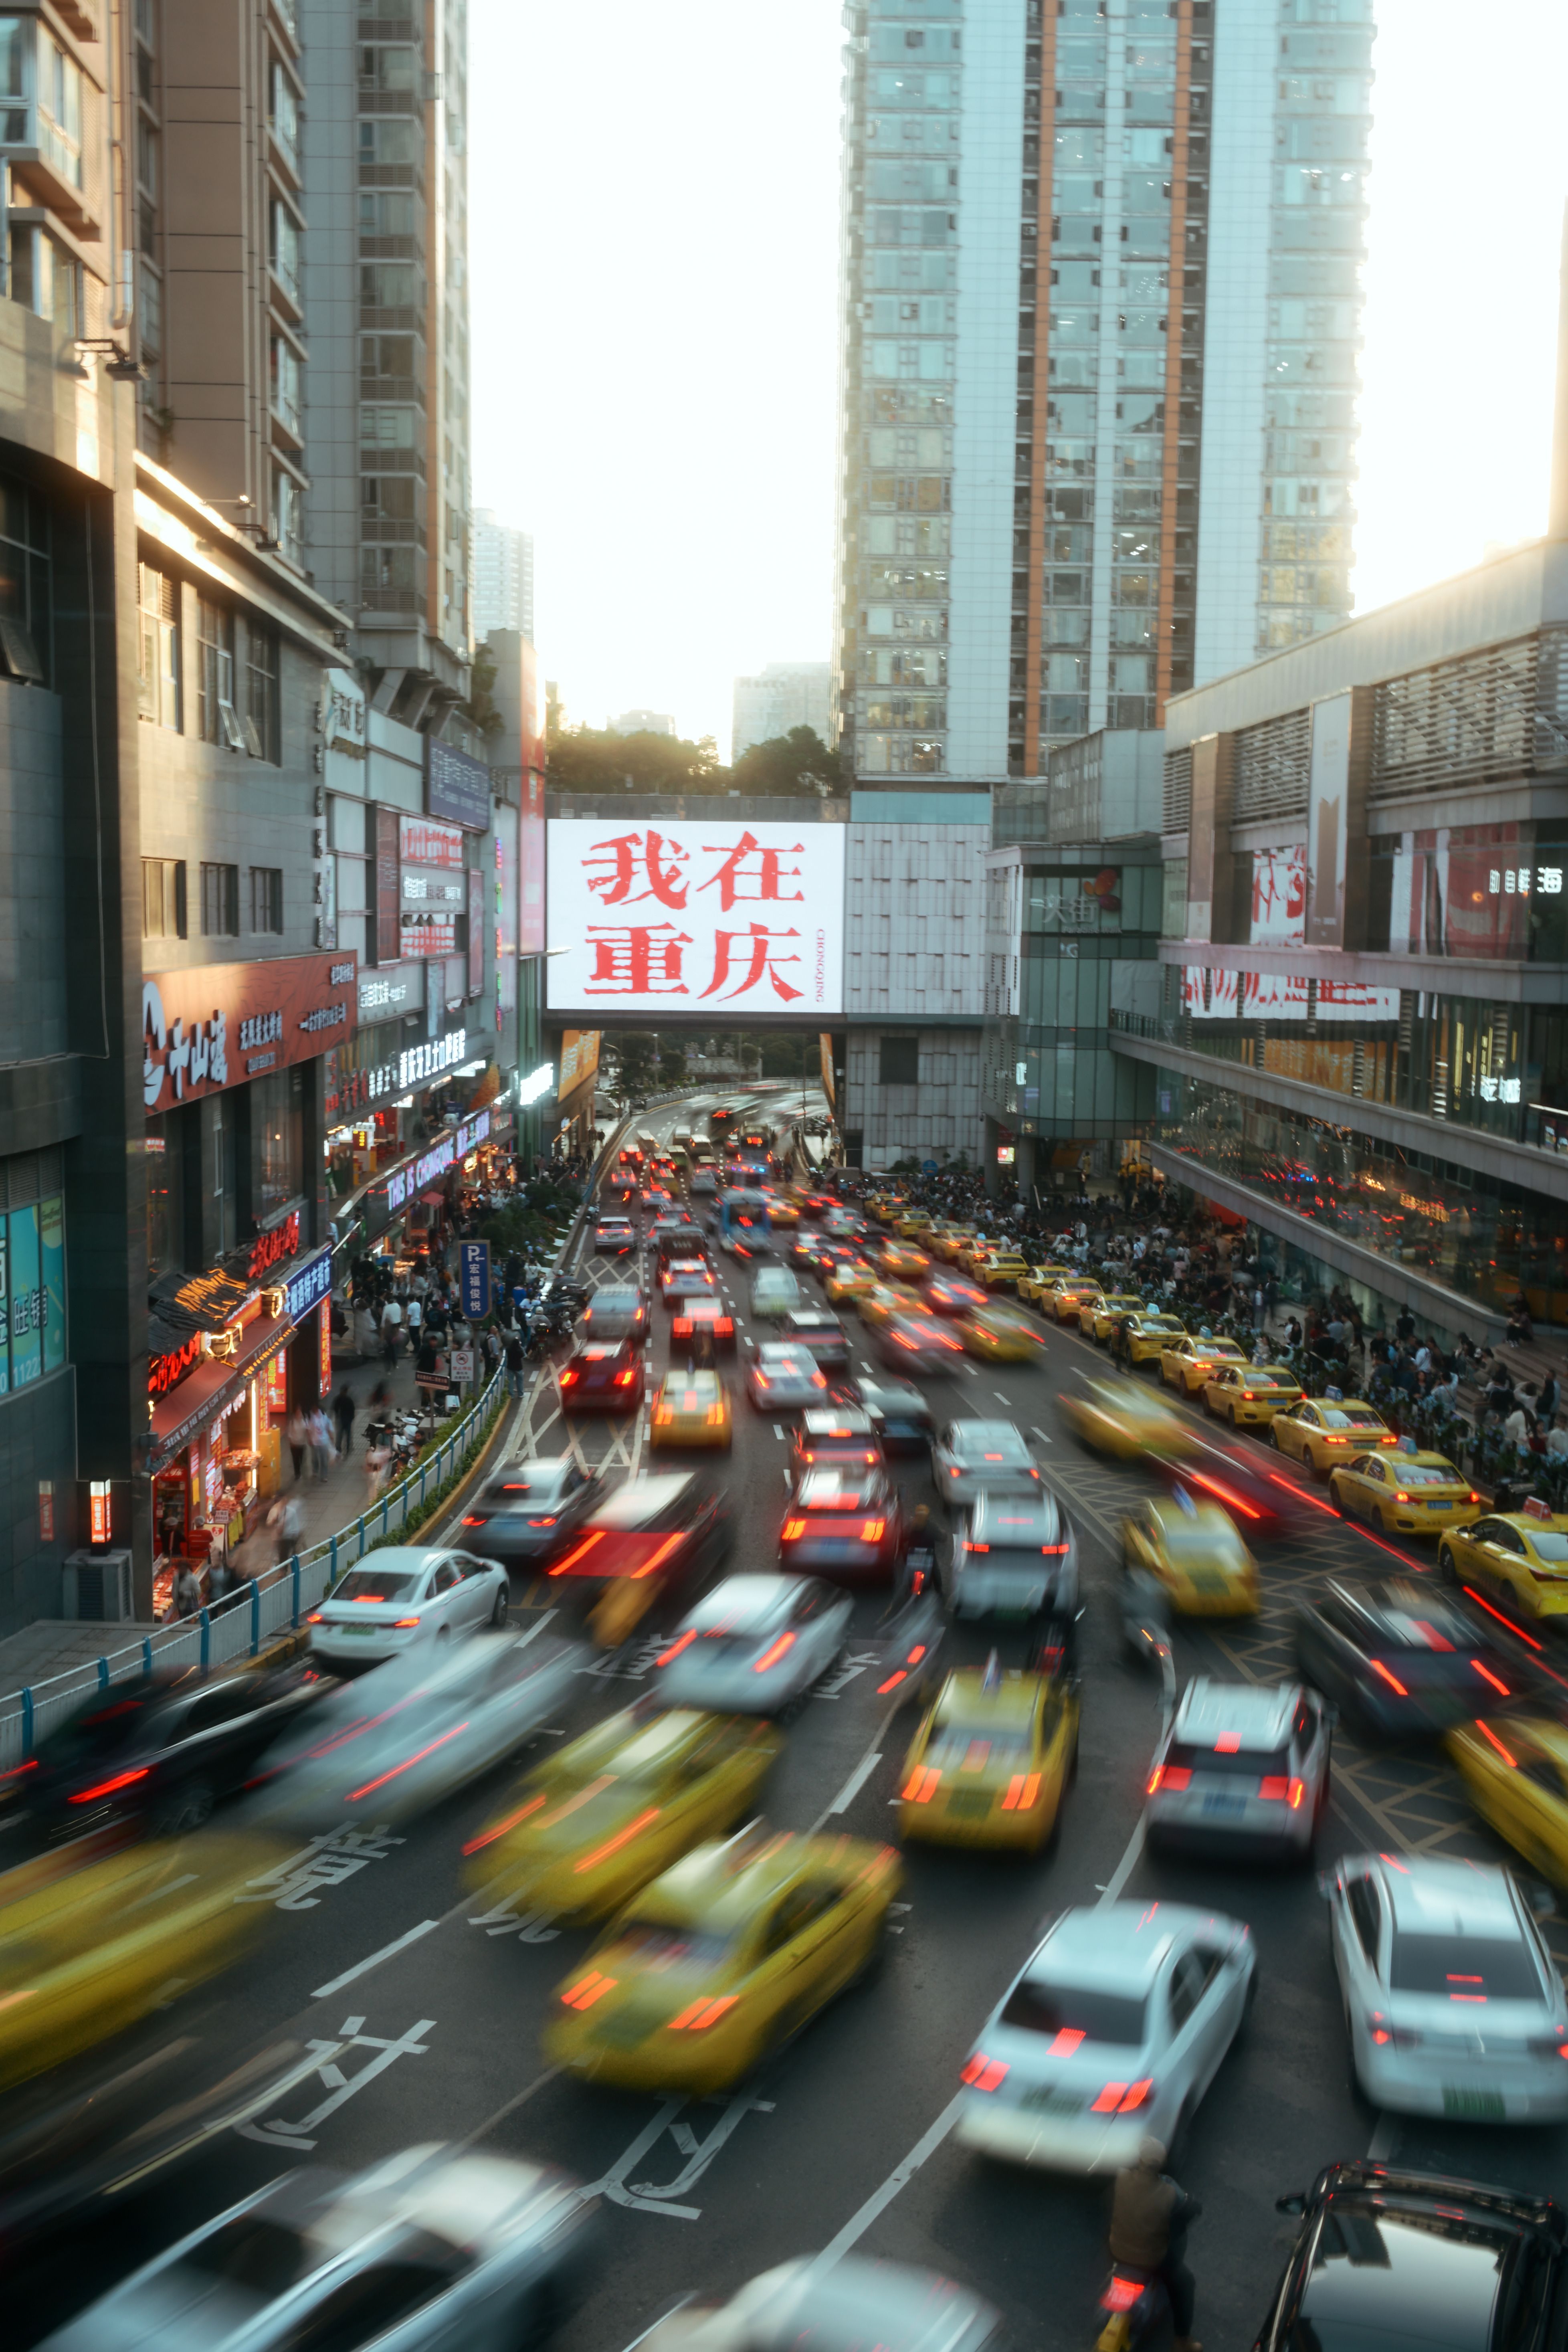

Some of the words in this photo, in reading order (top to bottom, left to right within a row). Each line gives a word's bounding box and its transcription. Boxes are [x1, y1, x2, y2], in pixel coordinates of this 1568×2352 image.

[581, 830, 805, 912] 我在
[584, 921, 805, 1002] 重庆
[815, 929, 825, 1003] CHONGQING
[399, 1028, 466, 1089] 重庆牙卫士口腔医院
[387, 1172, 405, 1211] THIS
[406, 1166, 414, 1197] IS
[416, 1136, 454, 1188] CHONGQING
[467, 1245, 480, 1262] P
[469, 1264, 482, 1312] 宏福俊悦
